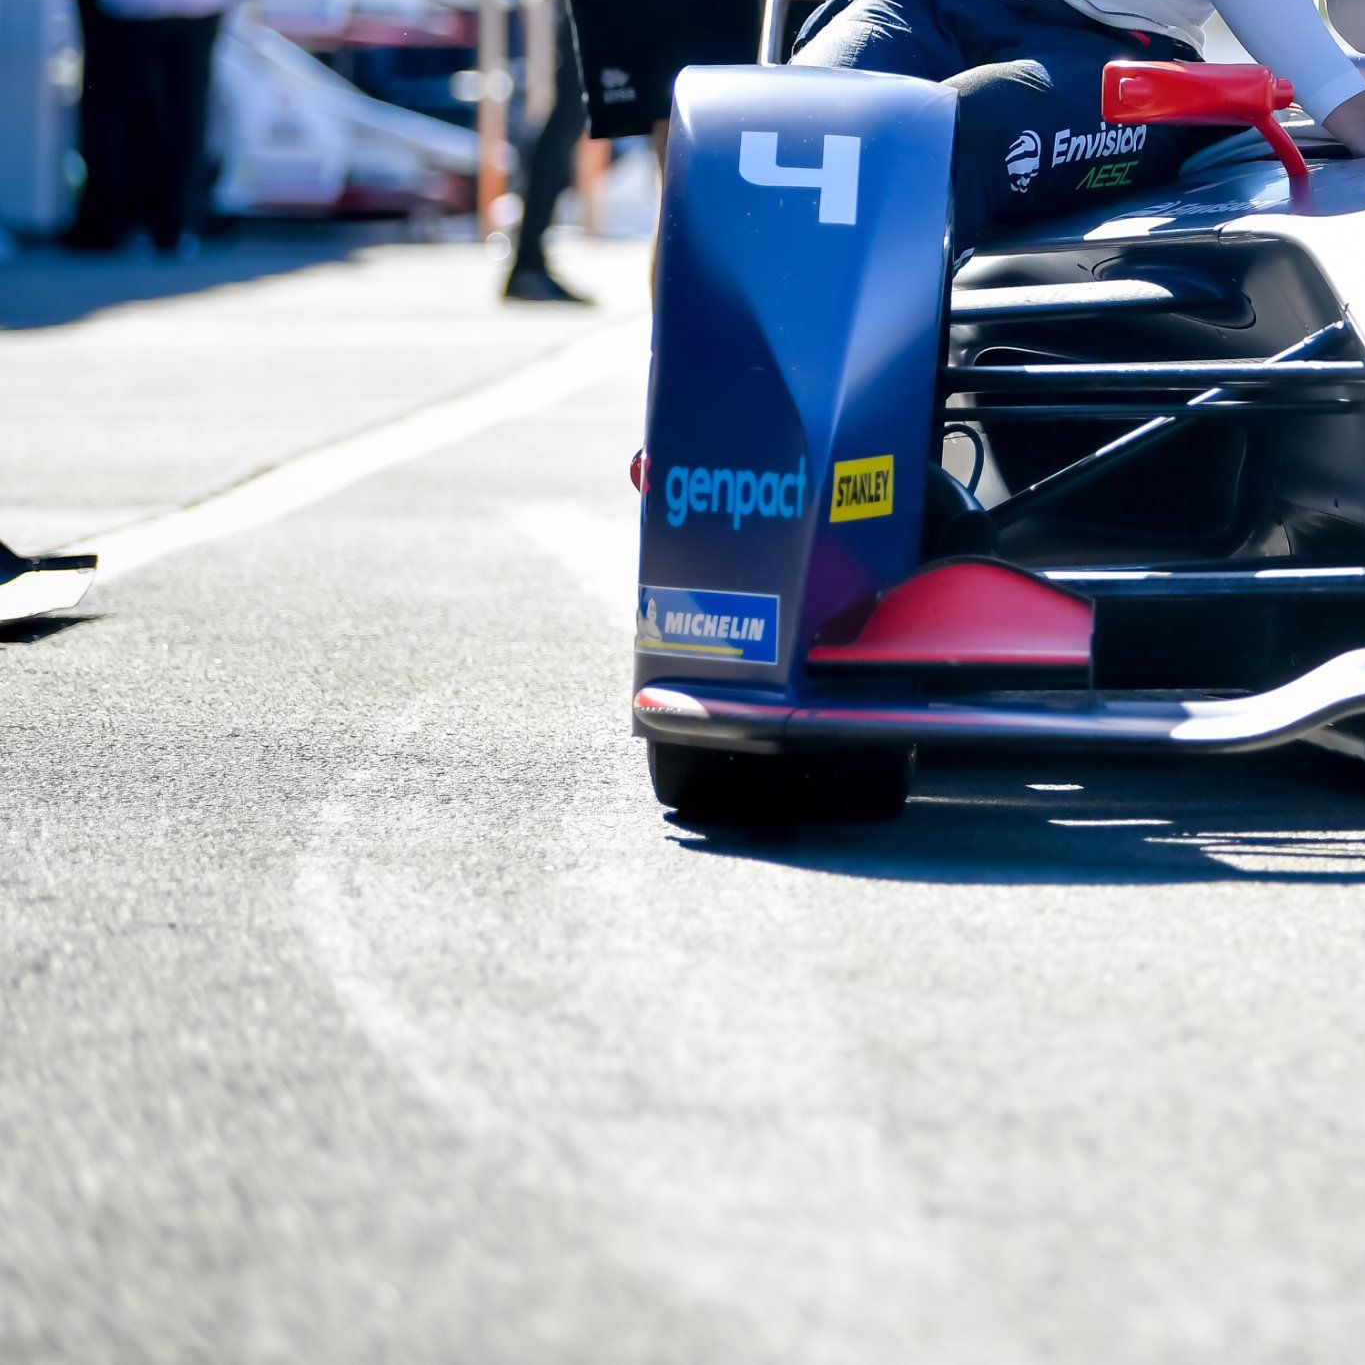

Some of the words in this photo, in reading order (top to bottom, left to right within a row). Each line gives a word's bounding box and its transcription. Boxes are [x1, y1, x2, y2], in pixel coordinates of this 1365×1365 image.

[1051, 121, 1148, 169] Envision
[738, 130, 861, 225] 4
[664, 455, 807, 531] genpact
[835, 469, 890, 508] STANLEY
[664, 611, 766, 642] MICHELIN
